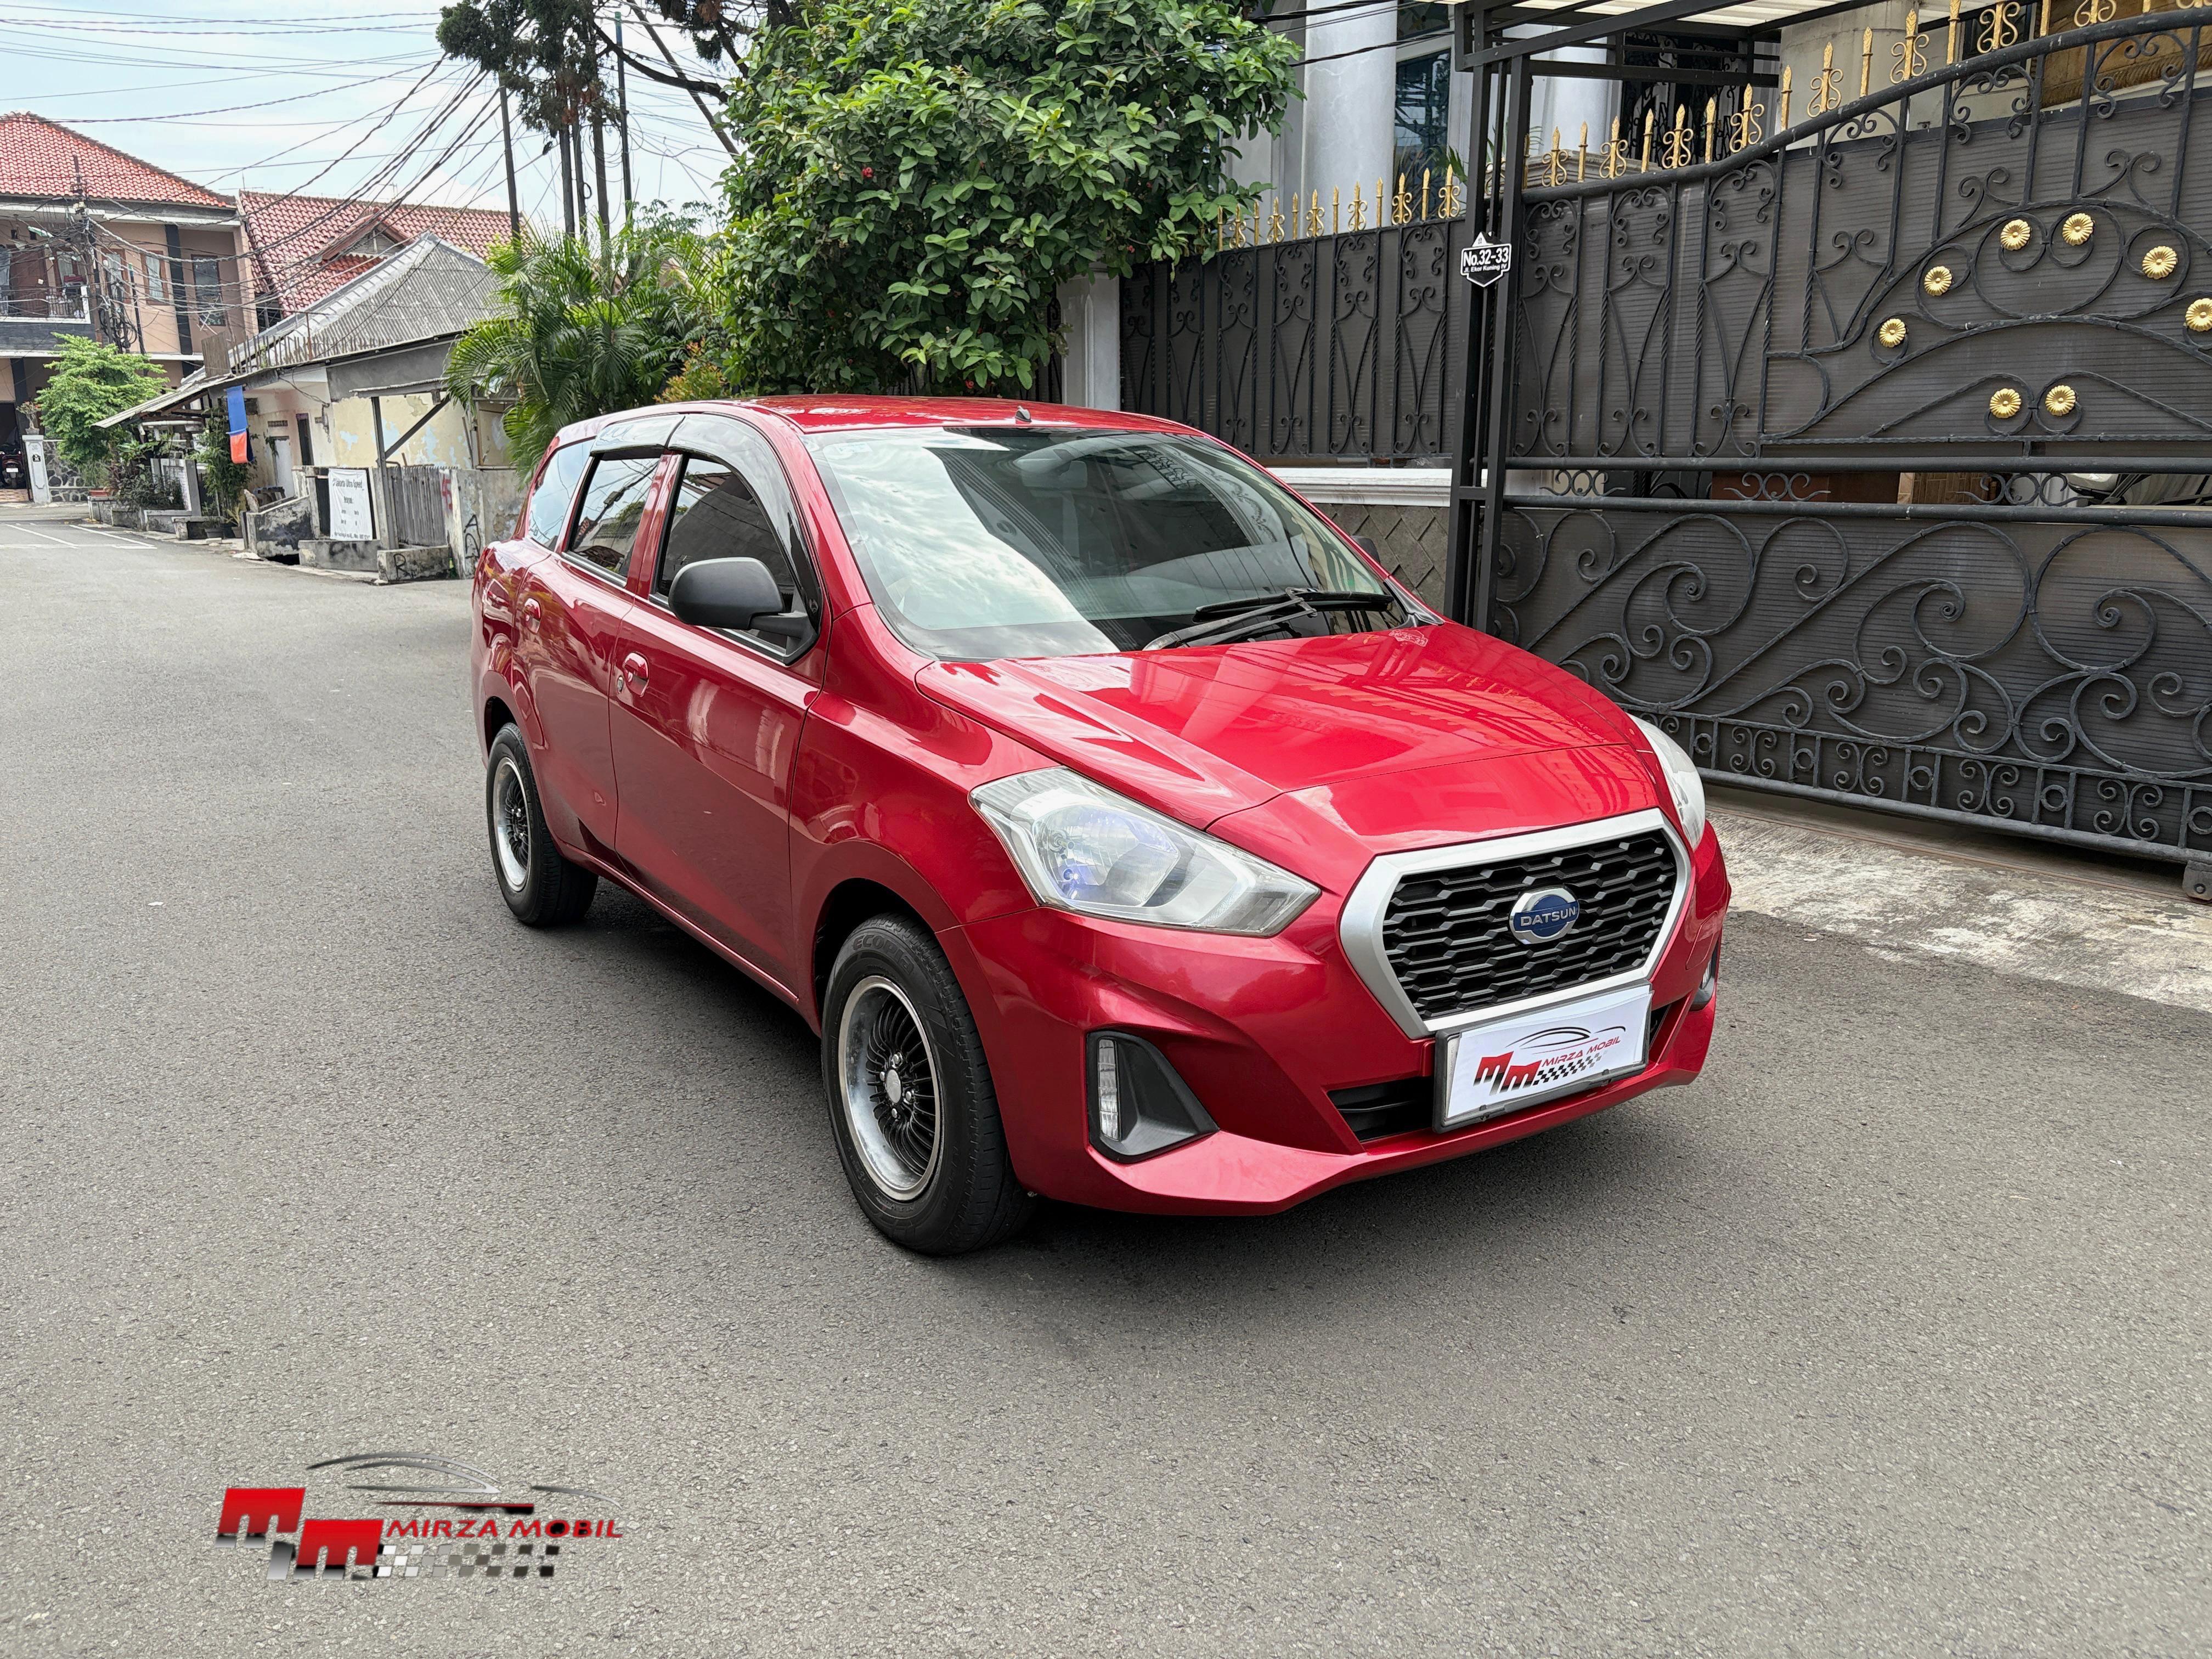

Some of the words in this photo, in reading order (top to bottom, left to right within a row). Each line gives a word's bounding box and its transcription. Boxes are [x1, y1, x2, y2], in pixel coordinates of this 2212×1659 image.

[1463, 248, 1509, 267] No.32-33
[1520, 906, 1576, 927] DATSUN
[1542, 1050, 1584, 1067] MIRZA
[1587, 1036, 1621, 1056] MOBIL
